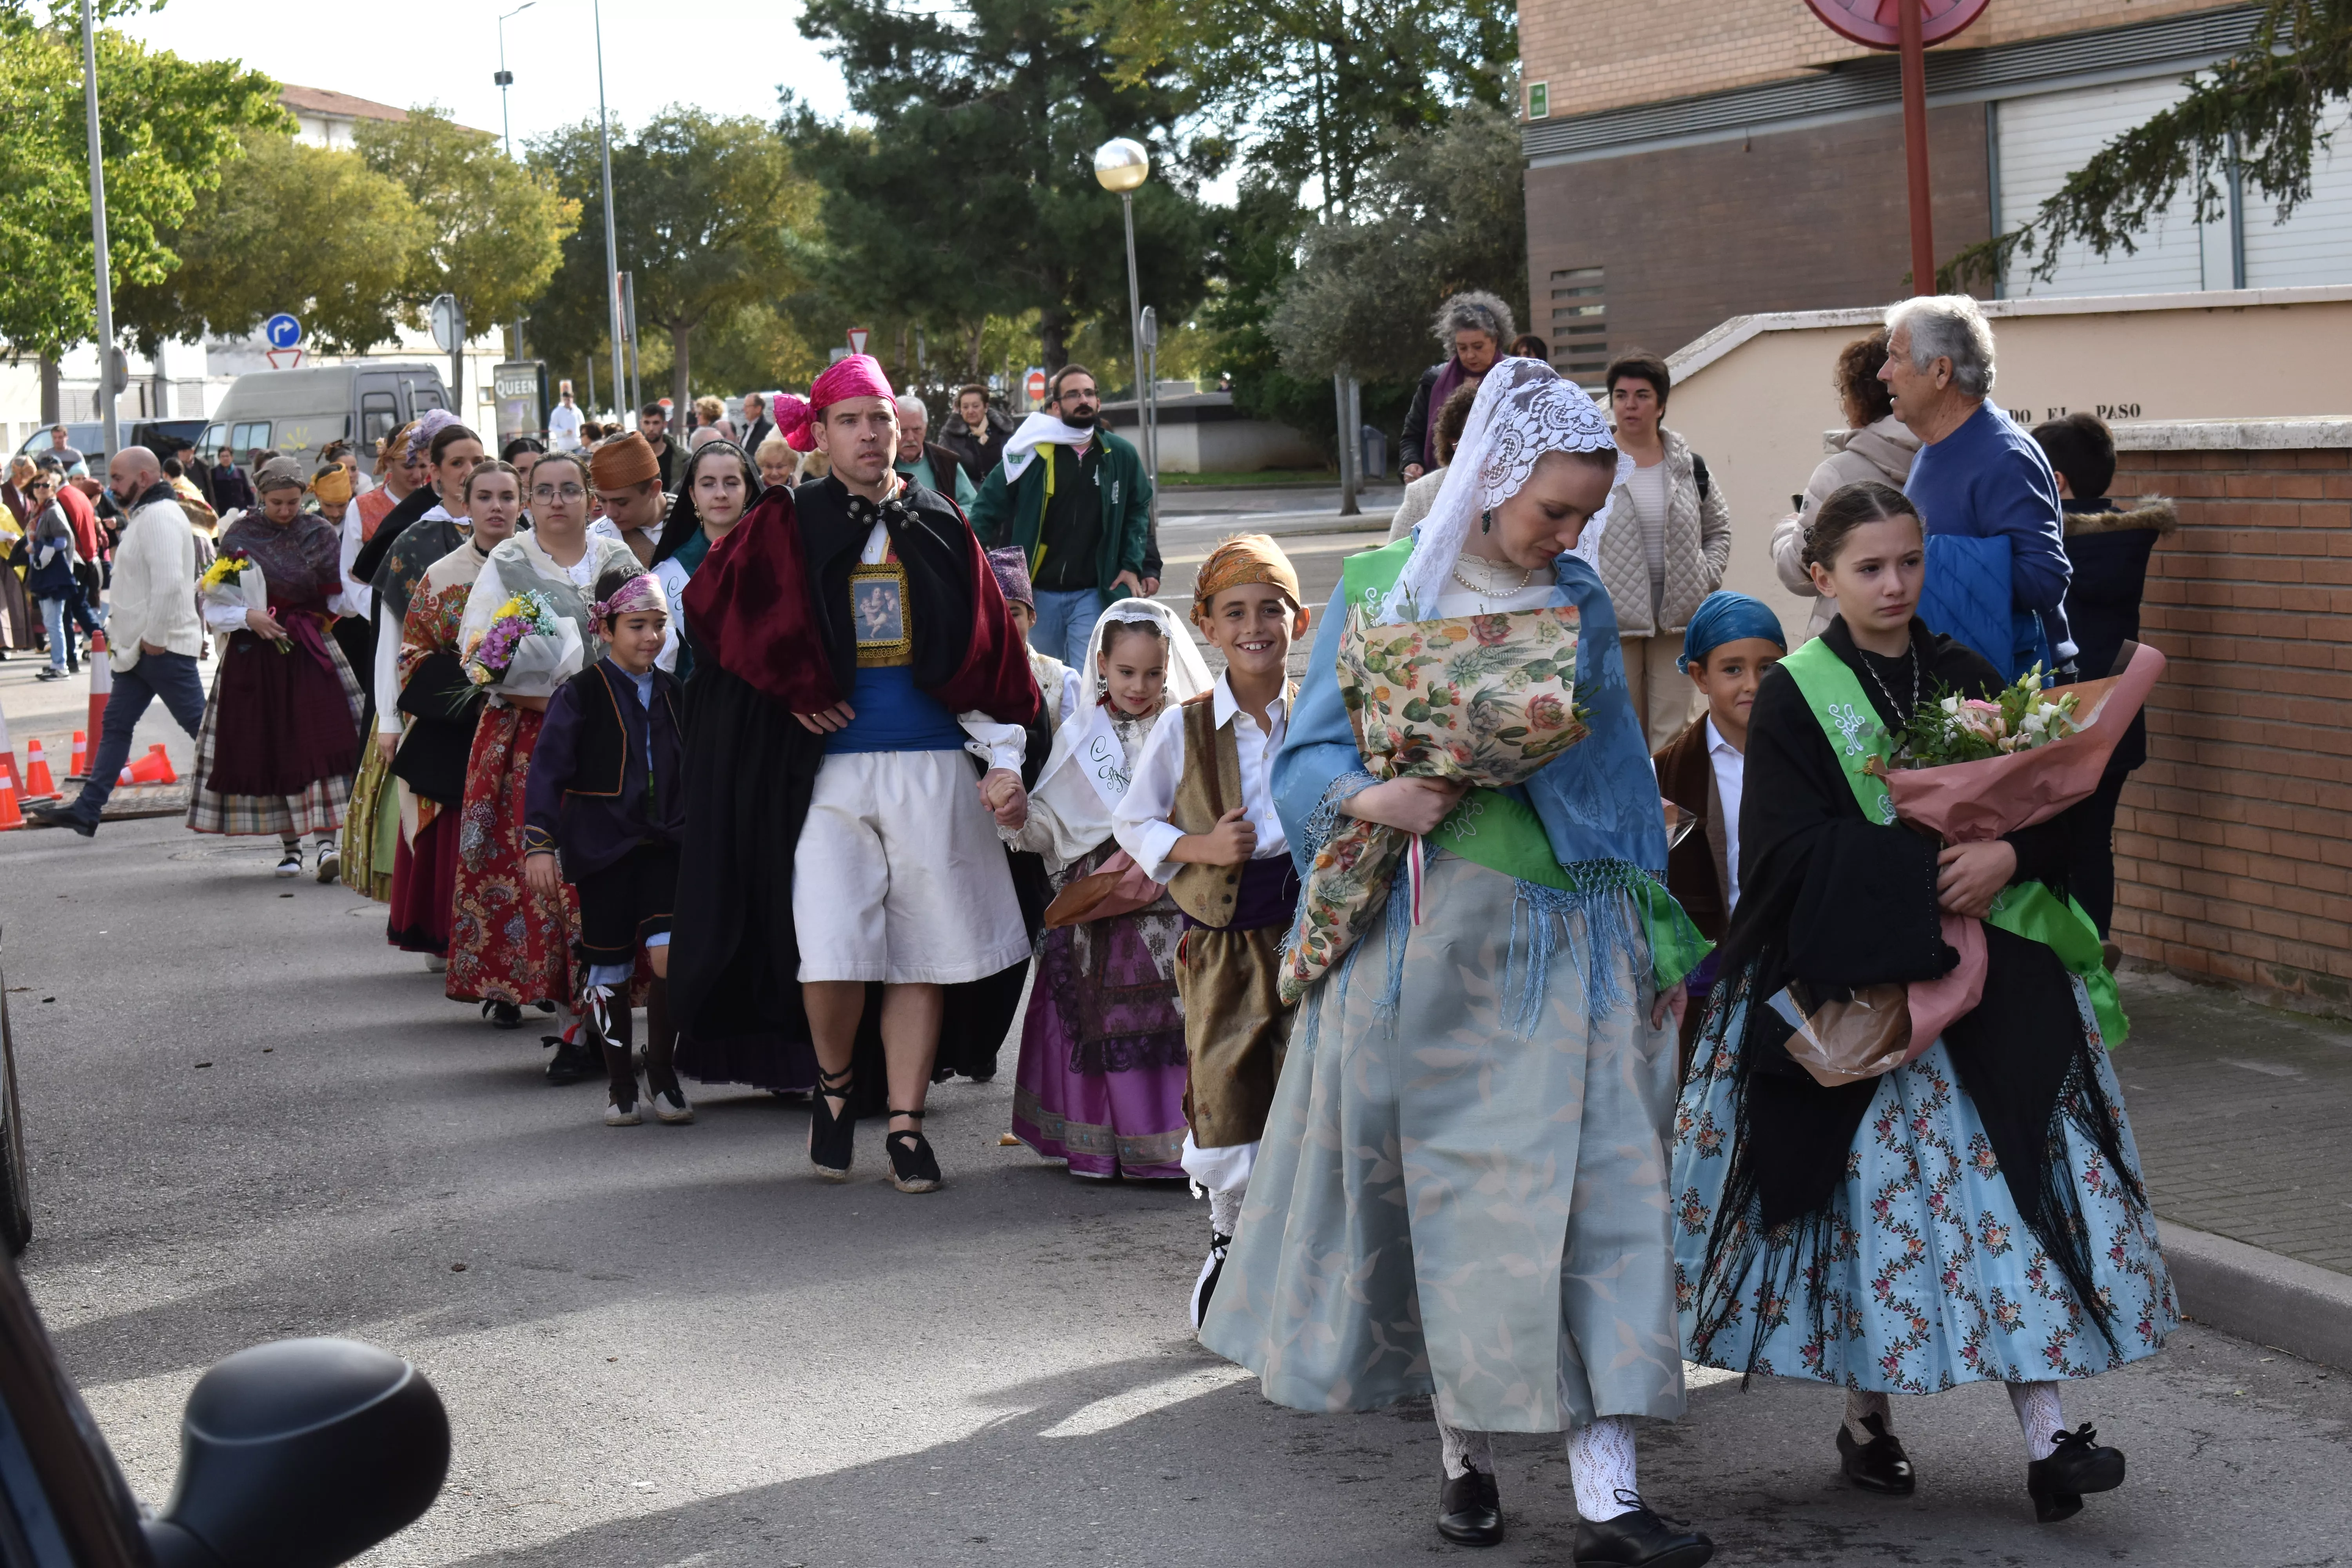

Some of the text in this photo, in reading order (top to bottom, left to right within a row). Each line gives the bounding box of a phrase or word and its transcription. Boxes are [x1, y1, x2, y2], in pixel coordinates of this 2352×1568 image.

[495, 380, 537, 398] QUEEN
[2096, 403, 2140, 419] PASO
[1444, 797, 1483, 842] 2023
